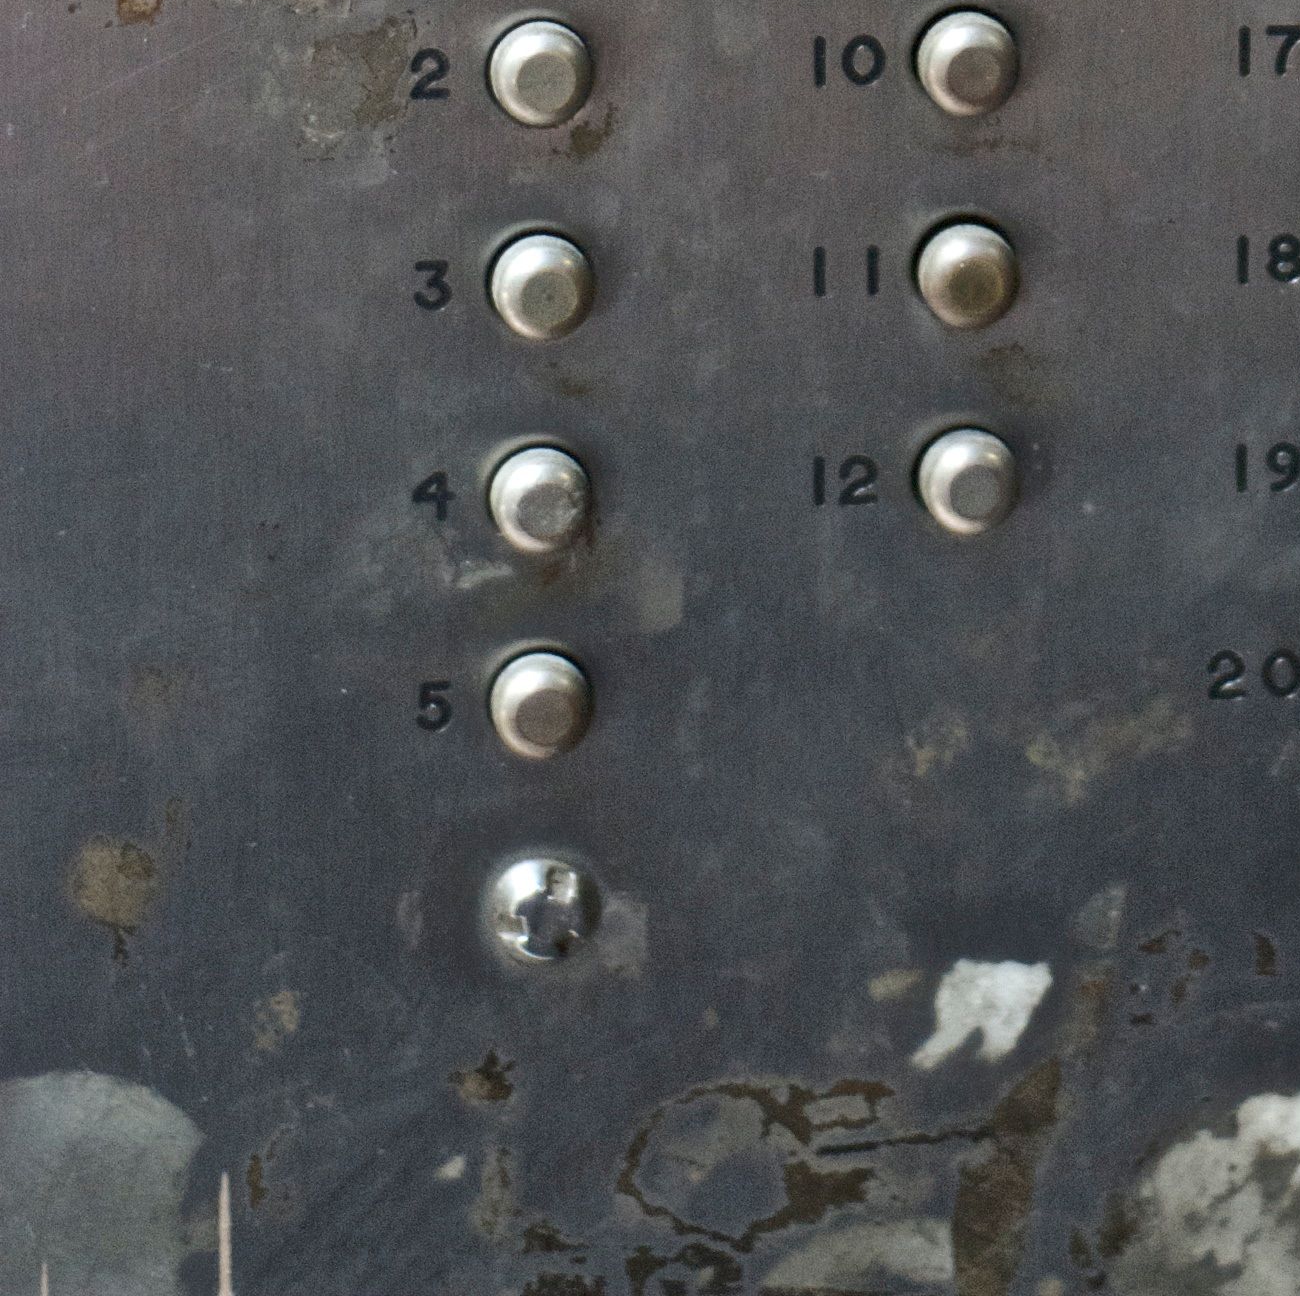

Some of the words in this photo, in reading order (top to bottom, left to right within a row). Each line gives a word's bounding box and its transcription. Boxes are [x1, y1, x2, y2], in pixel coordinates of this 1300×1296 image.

[409, 50, 450, 100] 2
[814, 37, 885, 86] 10
[414, 260, 451, 310] 3
[814, 246, 880, 297] 11
[412, 473, 454, 521] 4
[814, 456, 879, 506] 12
[416, 682, 451, 731] 5
